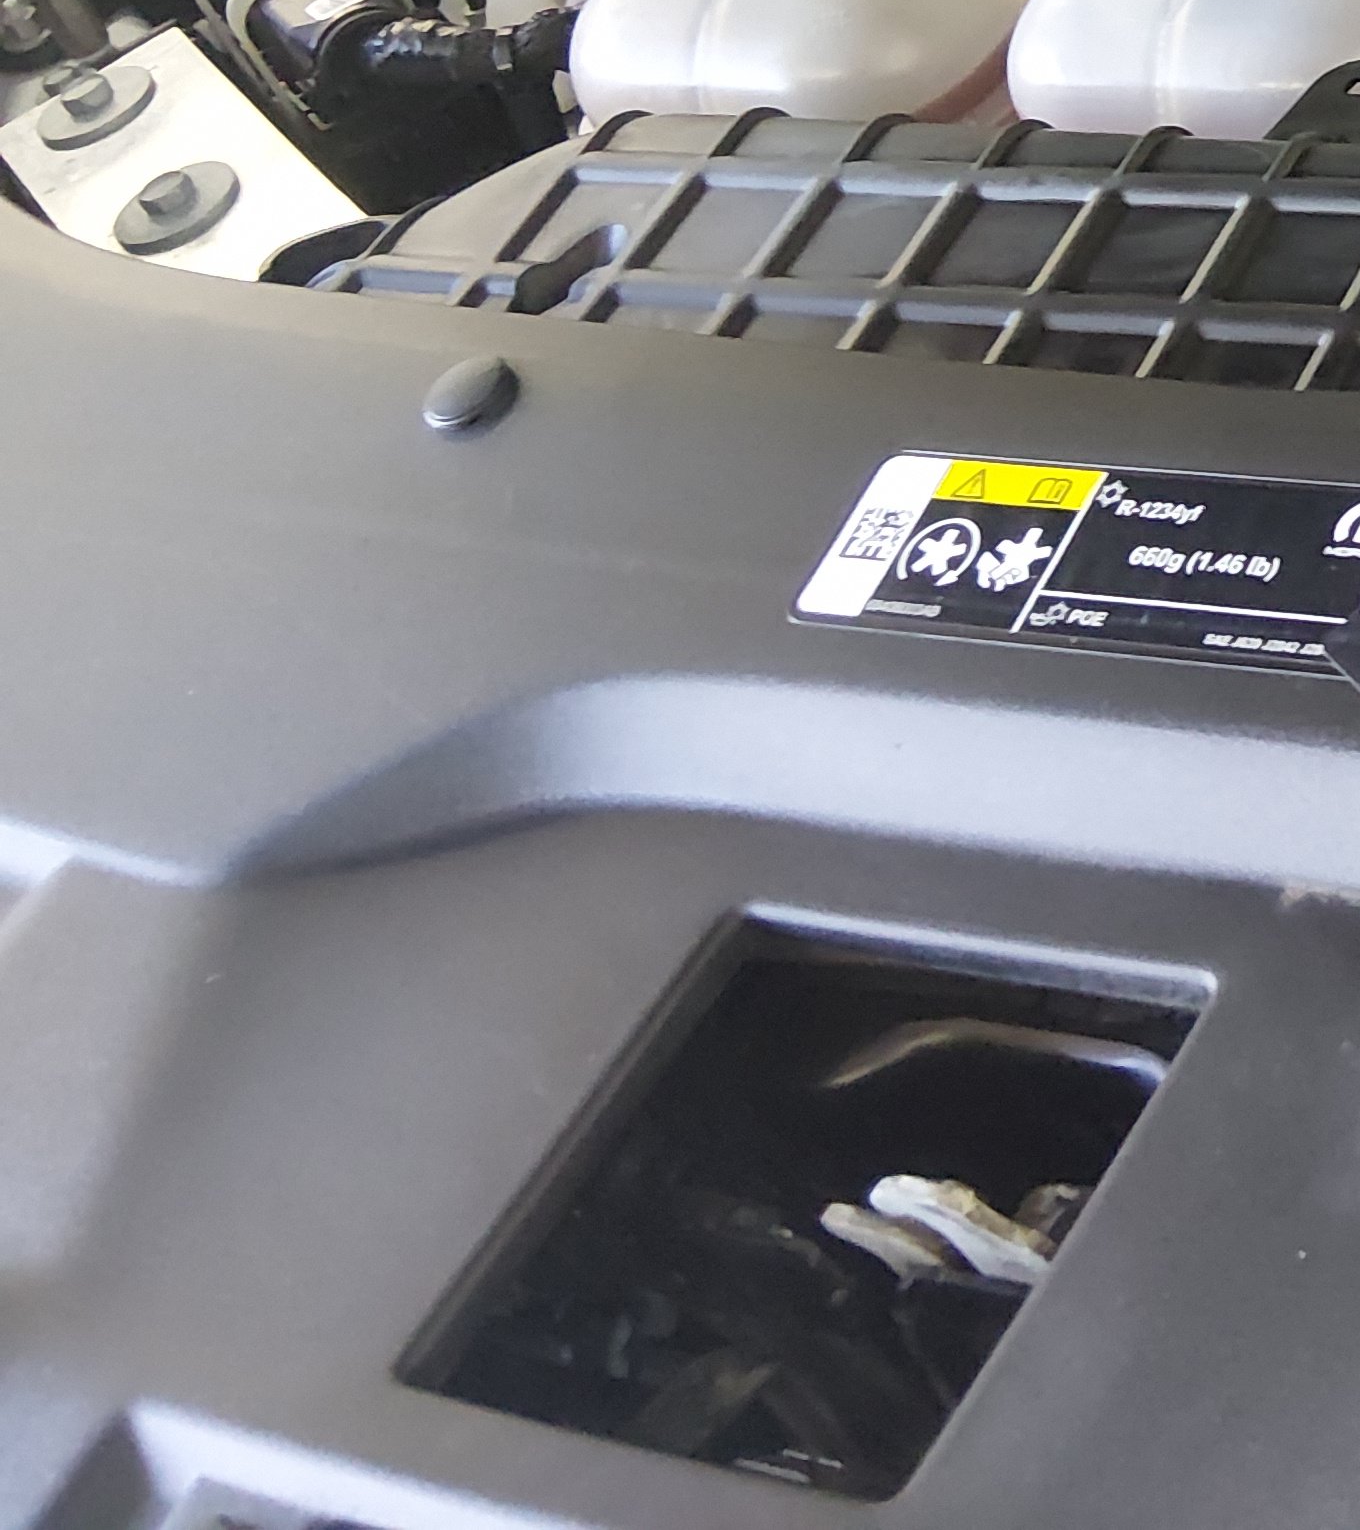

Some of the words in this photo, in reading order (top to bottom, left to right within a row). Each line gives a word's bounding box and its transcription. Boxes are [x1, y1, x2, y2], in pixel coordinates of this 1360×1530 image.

[1114, 499, 1206, 524] R-1234yf
[1128, 545, 1187, 574] 660g
[1185, 550, 1247, 575] (1.46
[1244, 555, 1282, 583] lb)
